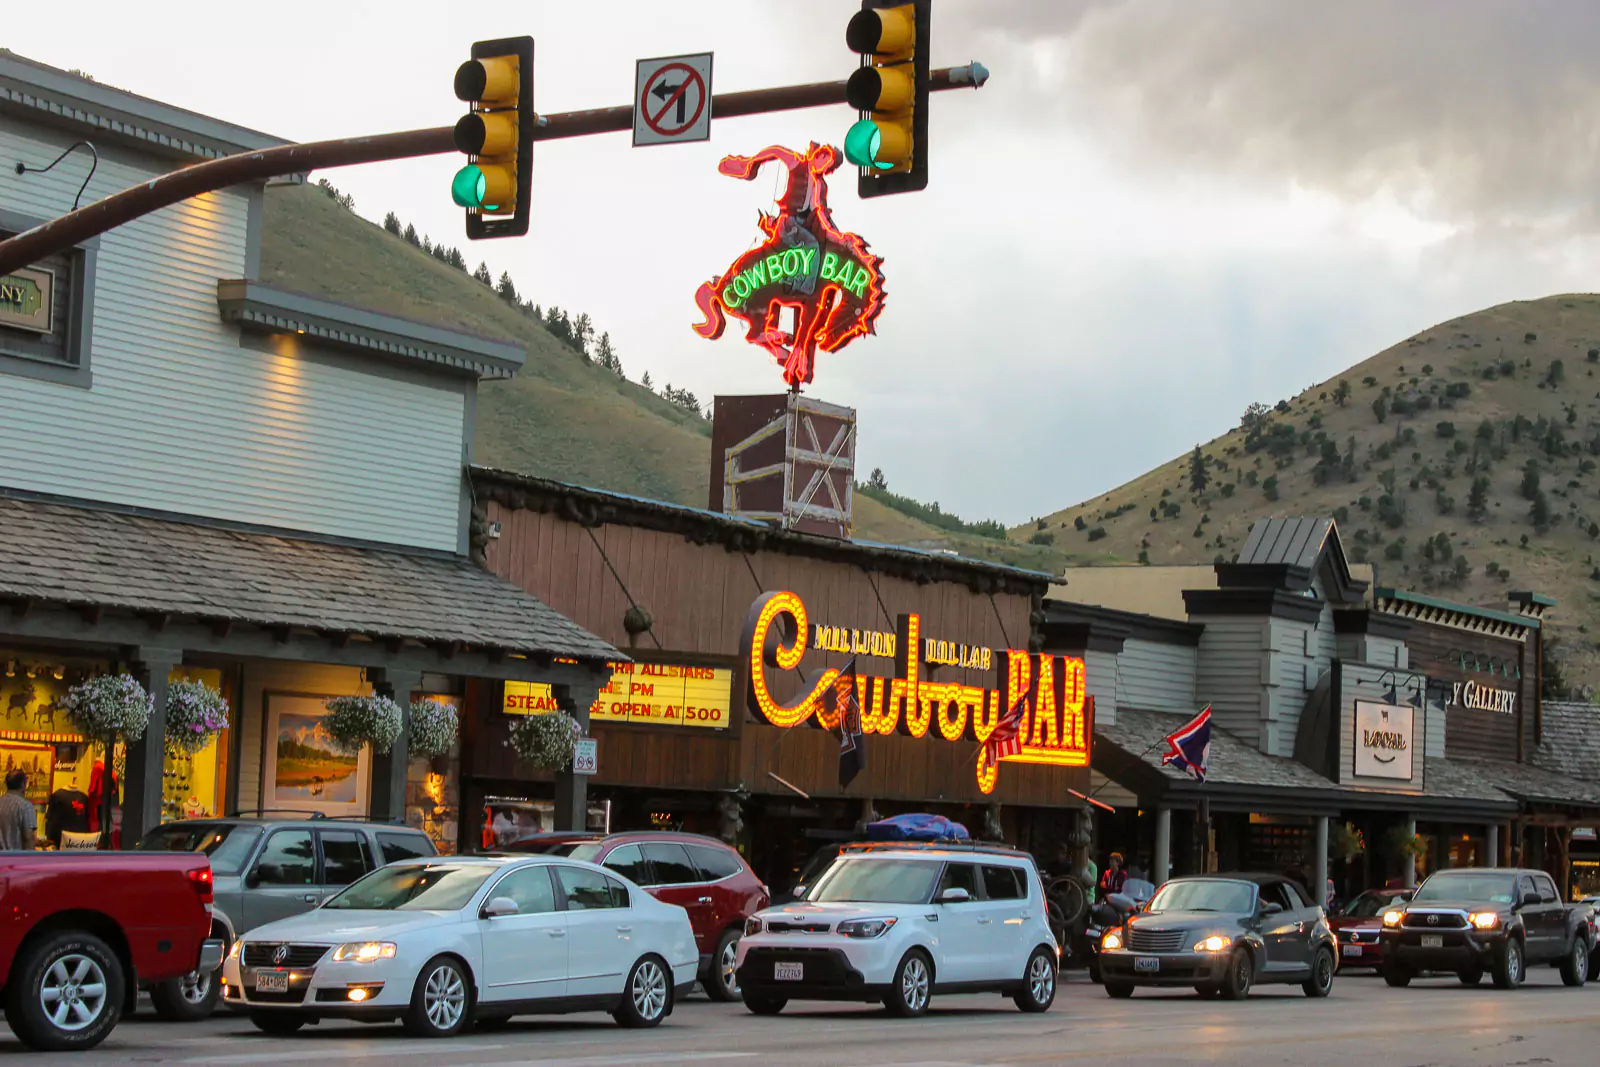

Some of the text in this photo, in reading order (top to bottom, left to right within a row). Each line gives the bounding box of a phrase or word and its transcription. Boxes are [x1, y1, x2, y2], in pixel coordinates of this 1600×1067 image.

[722, 248, 871, 308] COWBOY BAR
[815, 624, 991, 671] MILLION DOLLAR
[630, 682, 654, 697] PM
[1007, 648, 1087, 750] BAR
[611, 702, 662, 718] OPENS
[664, 705, 682, 719] AT
[685, 706, 721, 721] 500
[1364, 729, 1407, 751] LOCAL
